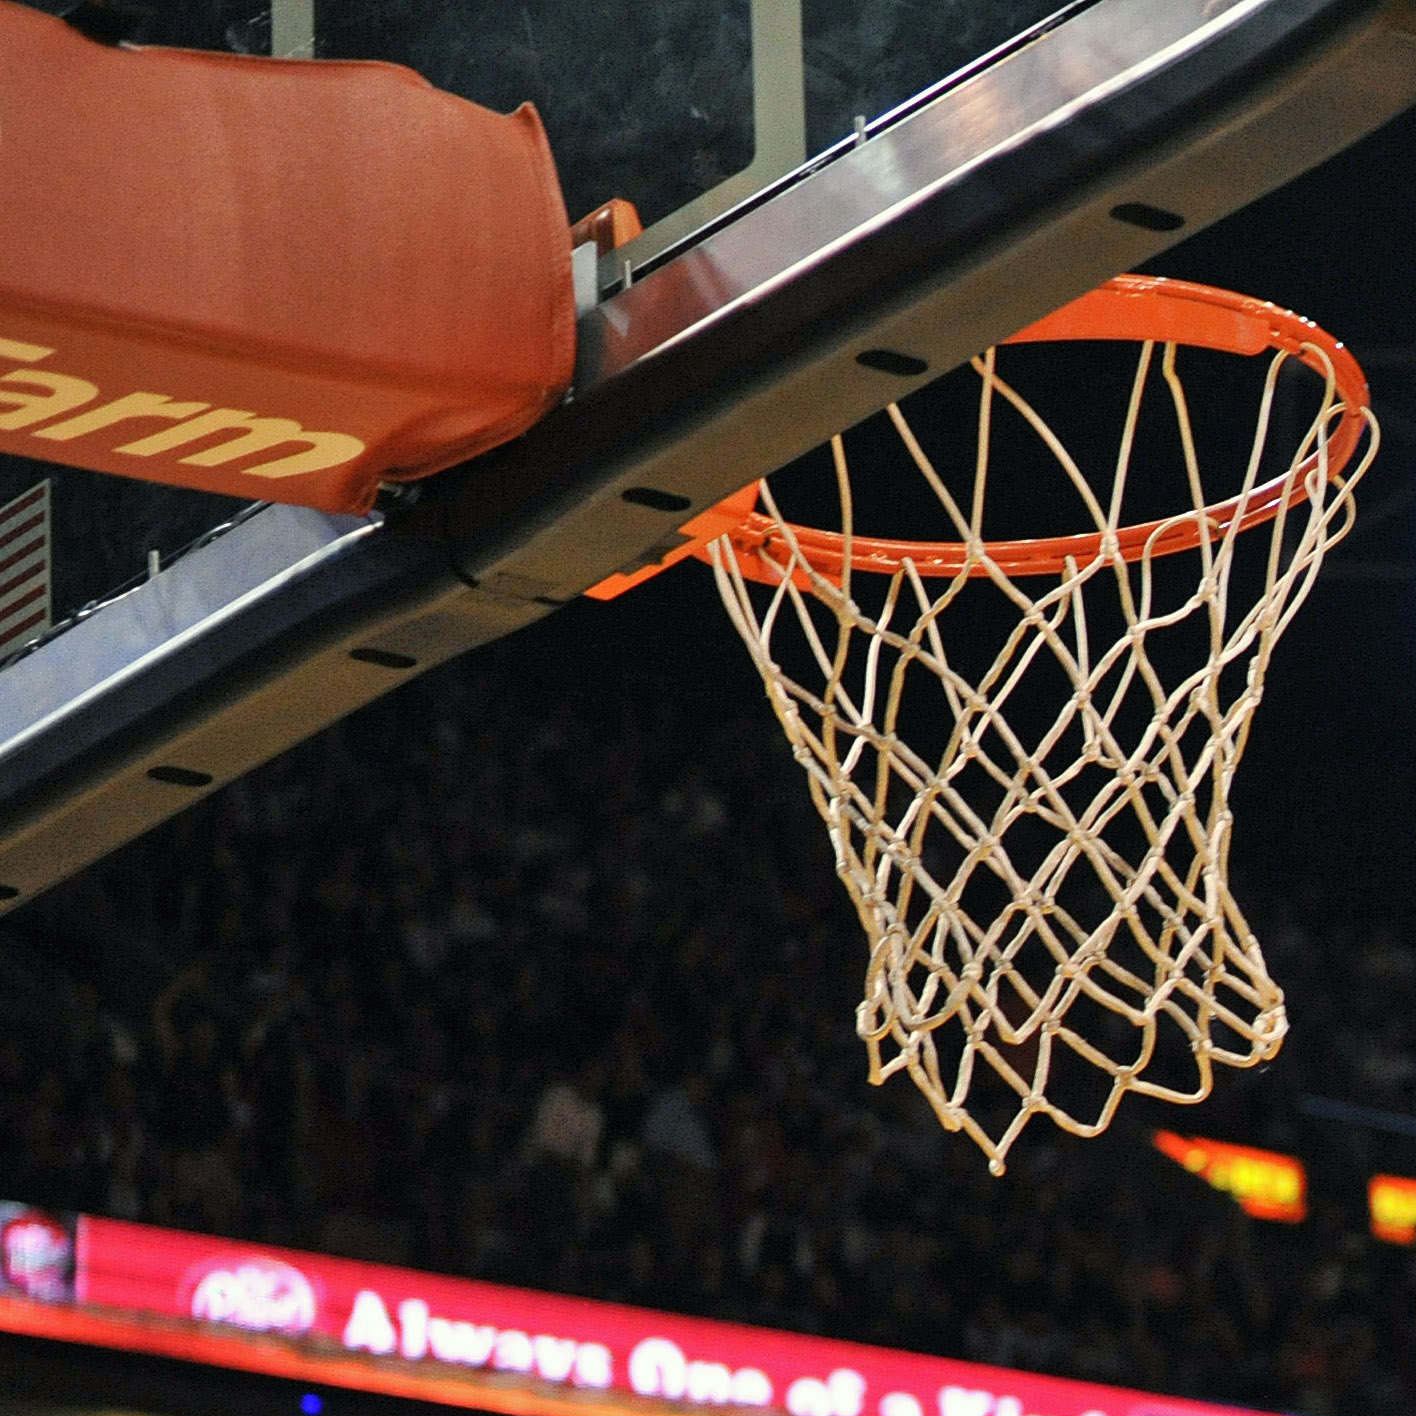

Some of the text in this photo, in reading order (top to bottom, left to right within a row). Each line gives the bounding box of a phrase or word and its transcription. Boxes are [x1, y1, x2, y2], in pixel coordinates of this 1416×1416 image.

[0, 337, 366, 479] arm
[343, 1290, 615, 1388] Always
[627, 1337, 773, 1405] One
